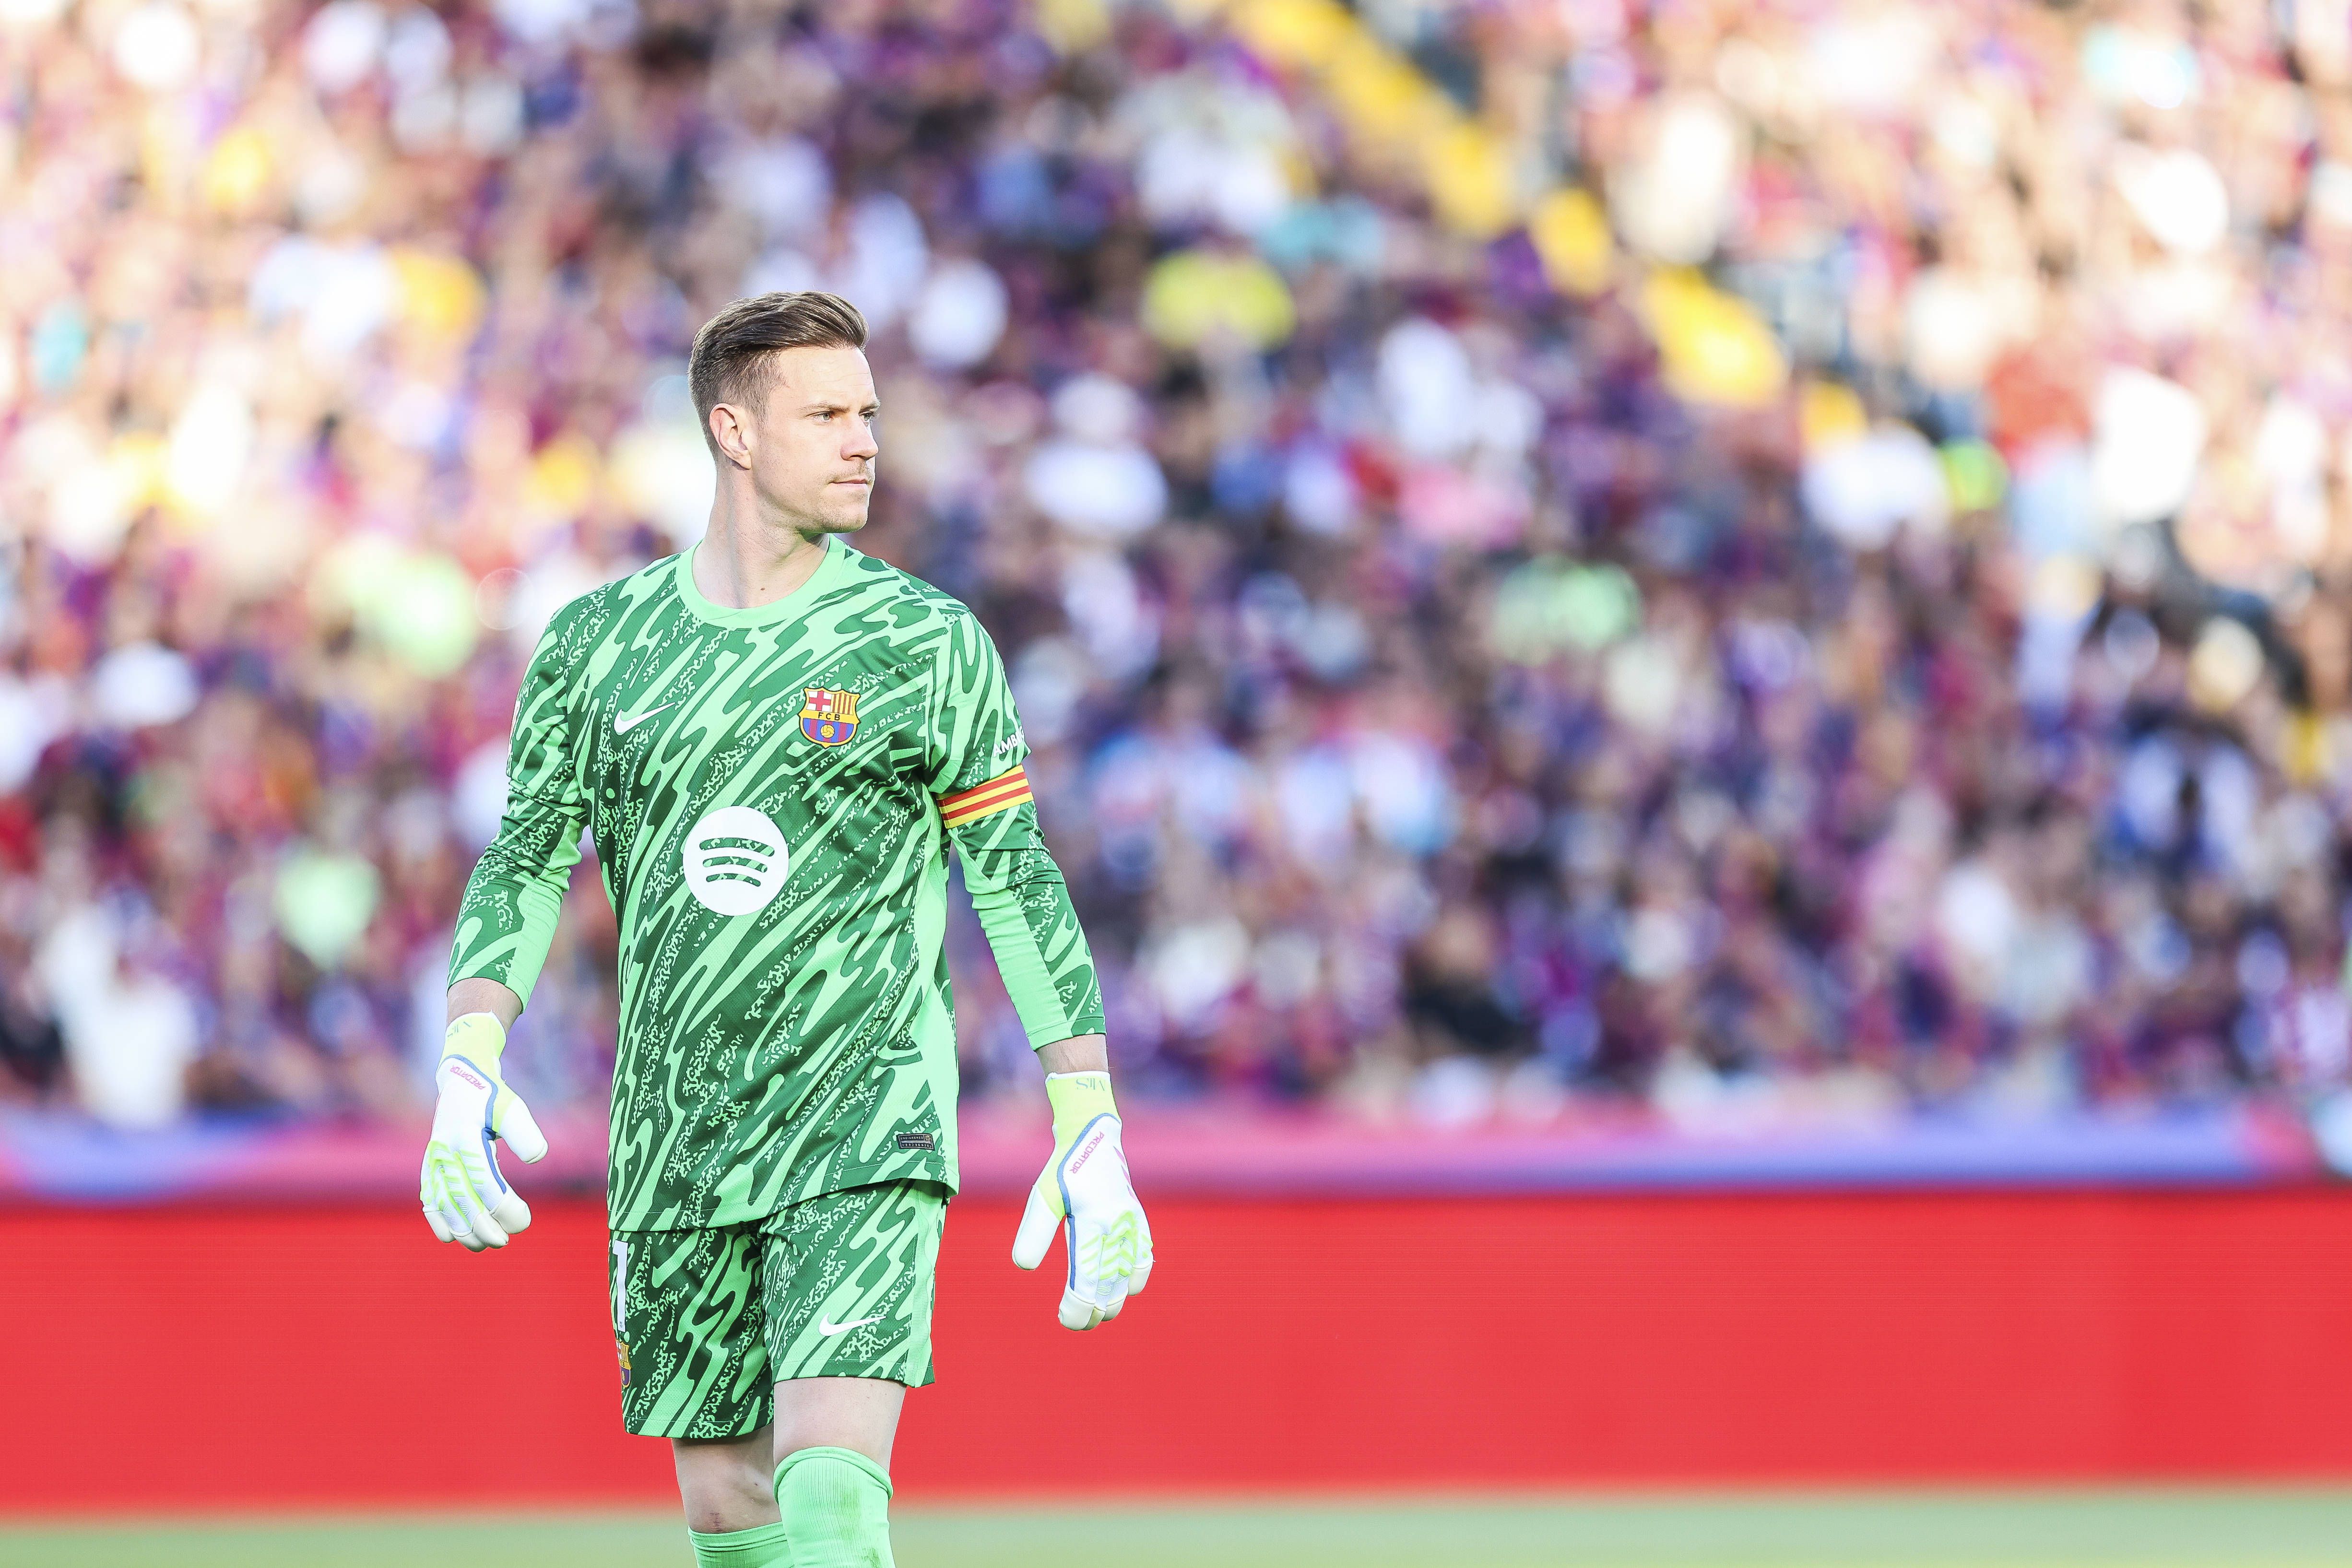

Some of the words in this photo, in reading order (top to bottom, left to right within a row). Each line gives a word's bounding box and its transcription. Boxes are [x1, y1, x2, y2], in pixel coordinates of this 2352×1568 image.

[817, 711, 840, 721] FCB
[449, 1064, 486, 1090] PREDATOR
[1069, 1131, 1105, 1174] PREDATOR
